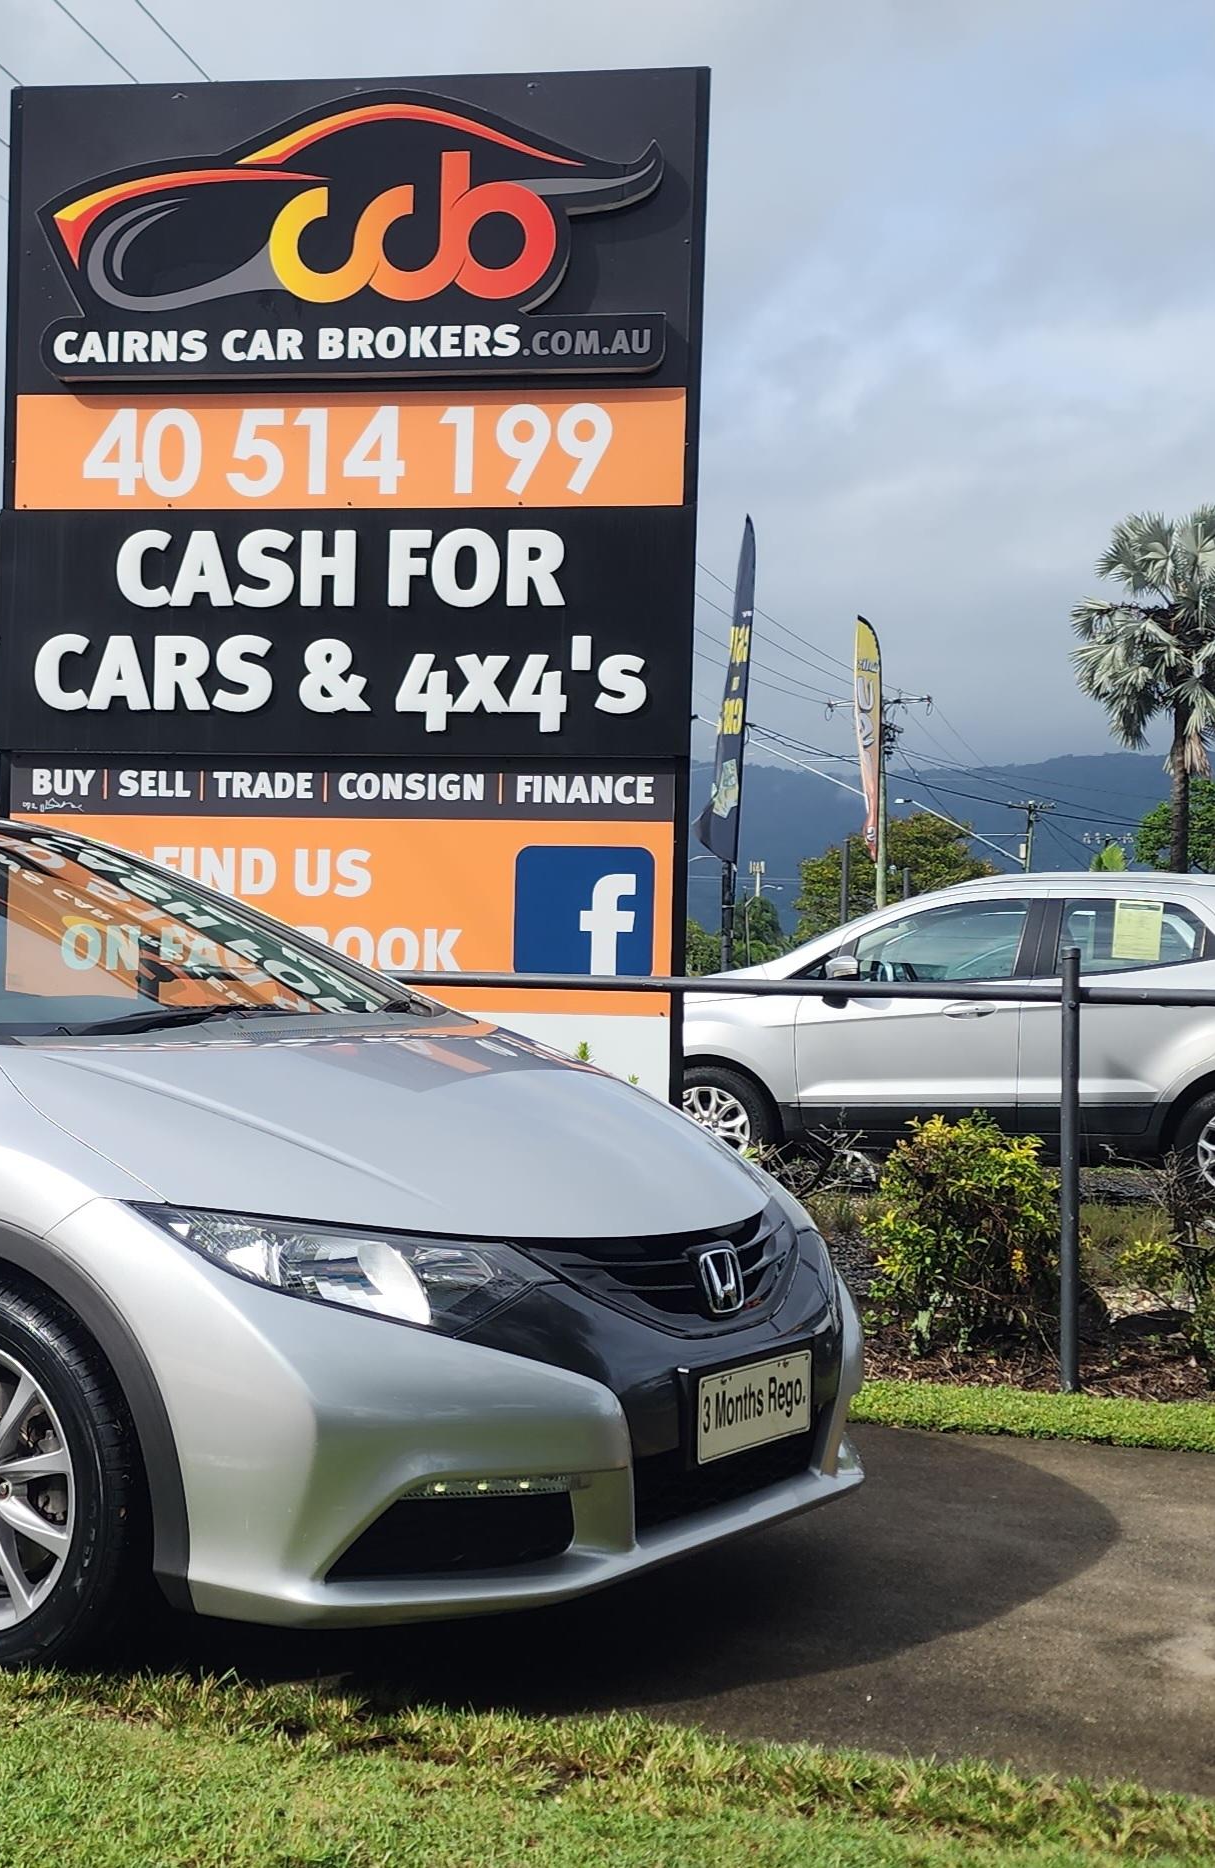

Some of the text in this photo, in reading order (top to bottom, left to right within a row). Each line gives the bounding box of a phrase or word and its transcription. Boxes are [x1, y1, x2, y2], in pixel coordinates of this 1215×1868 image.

[53, 329, 207, 363] CAIRNS
[221, 328, 304, 361] CAR
[83, 402, 613, 497] 40 514 199
[116, 528, 566, 609] CASH FOR
[33, 633, 273, 712] CARS
[298, 637, 372, 713] &
[32, 768, 656, 804] BUY SELL TRADE CONSIGN FINANCE
[153, 846, 373, 898] FIND US
[60, 923, 141, 972] ON
[702, 1376, 806, 1434] 3 Months Rego.
